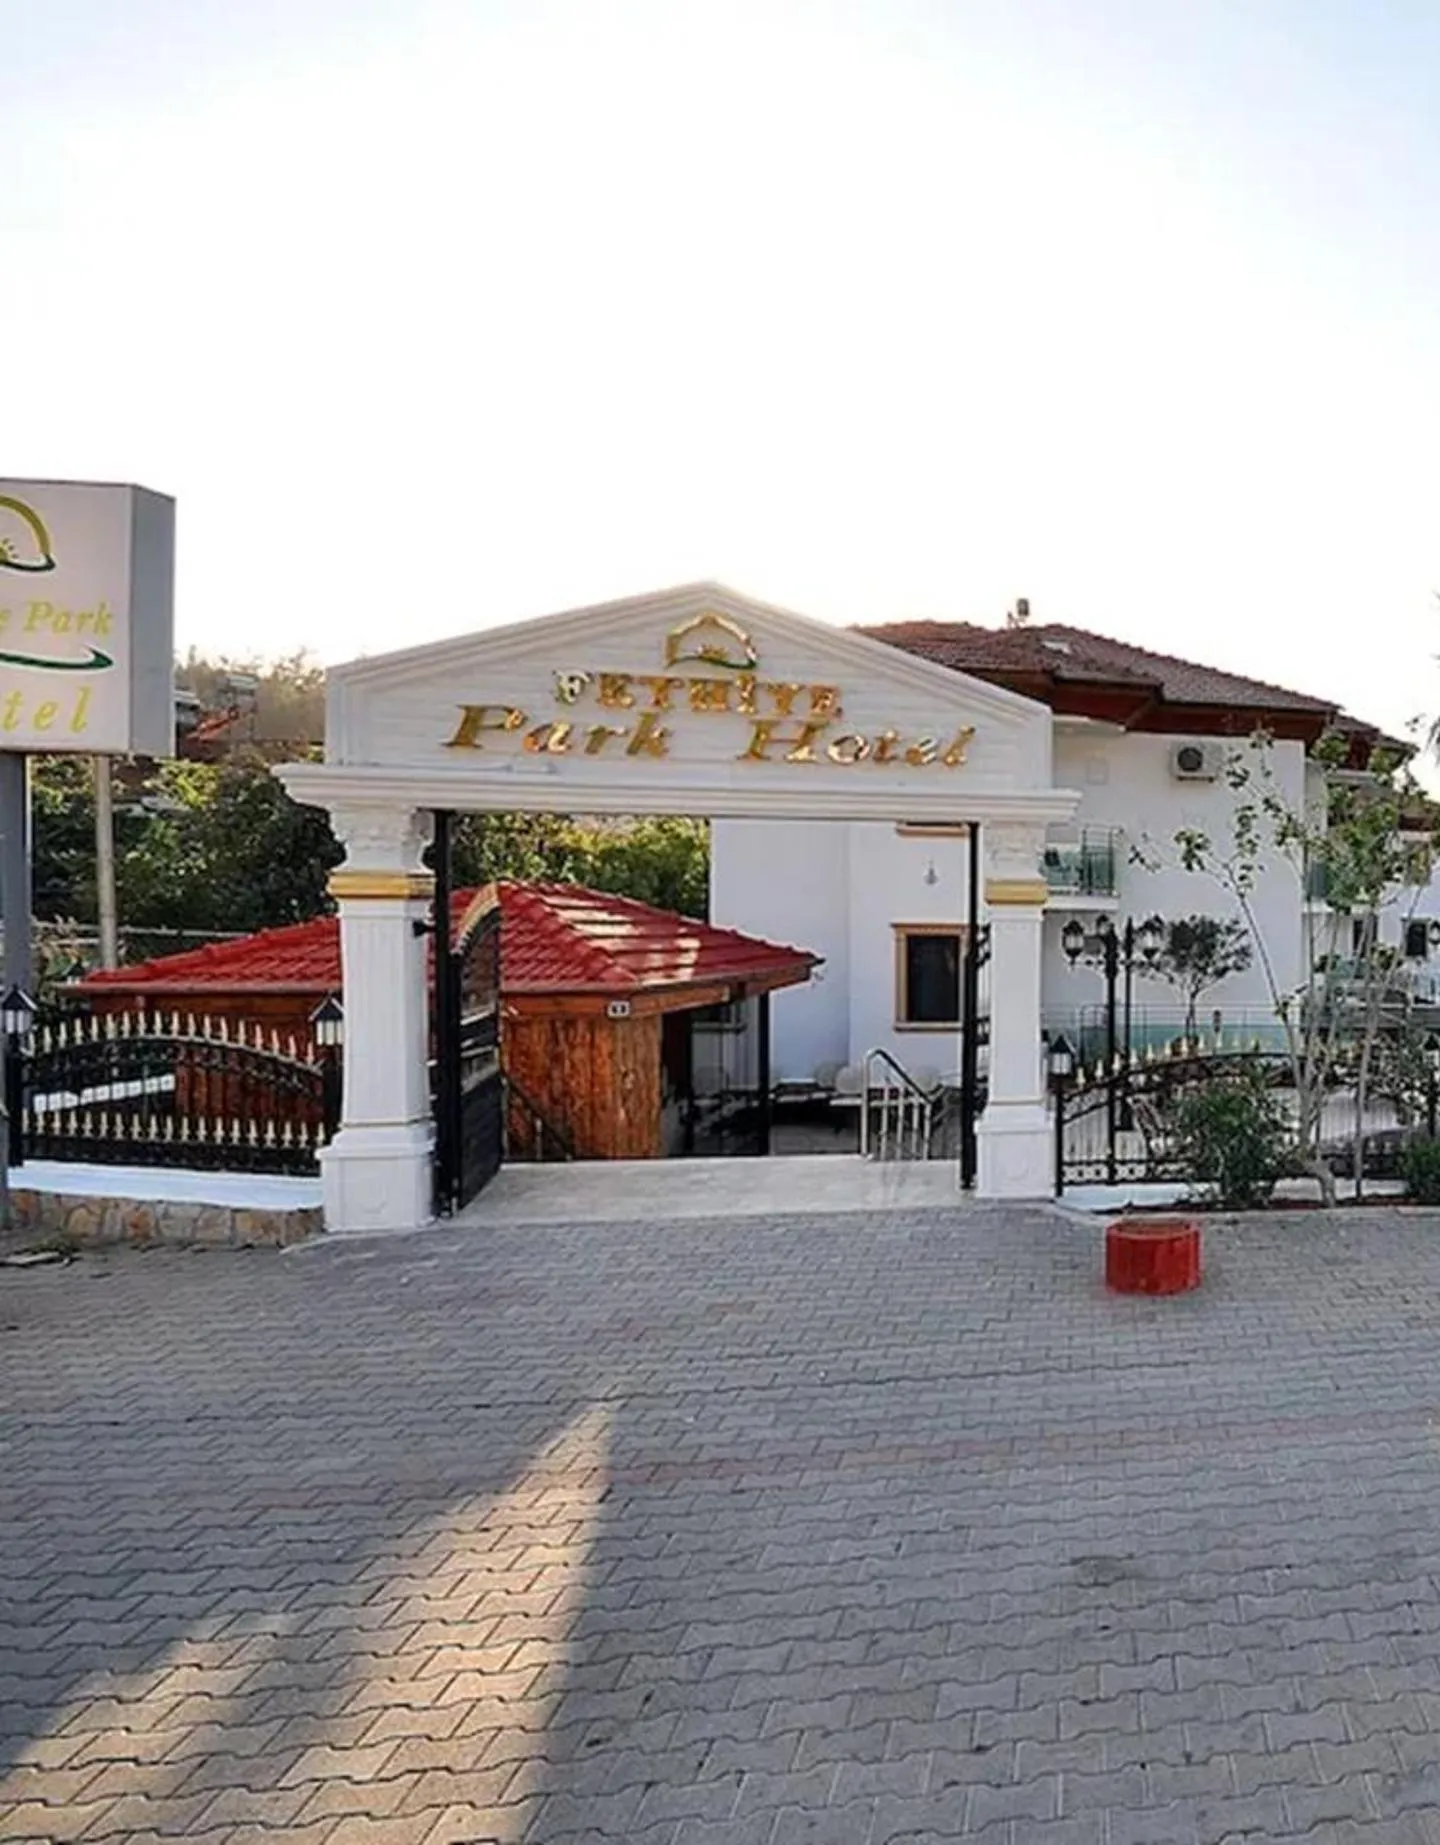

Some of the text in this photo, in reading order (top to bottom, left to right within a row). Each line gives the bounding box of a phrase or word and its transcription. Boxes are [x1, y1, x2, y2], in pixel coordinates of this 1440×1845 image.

[24, 600, 113, 635] Park
[439, 704, 977, 767] Park Hotel
